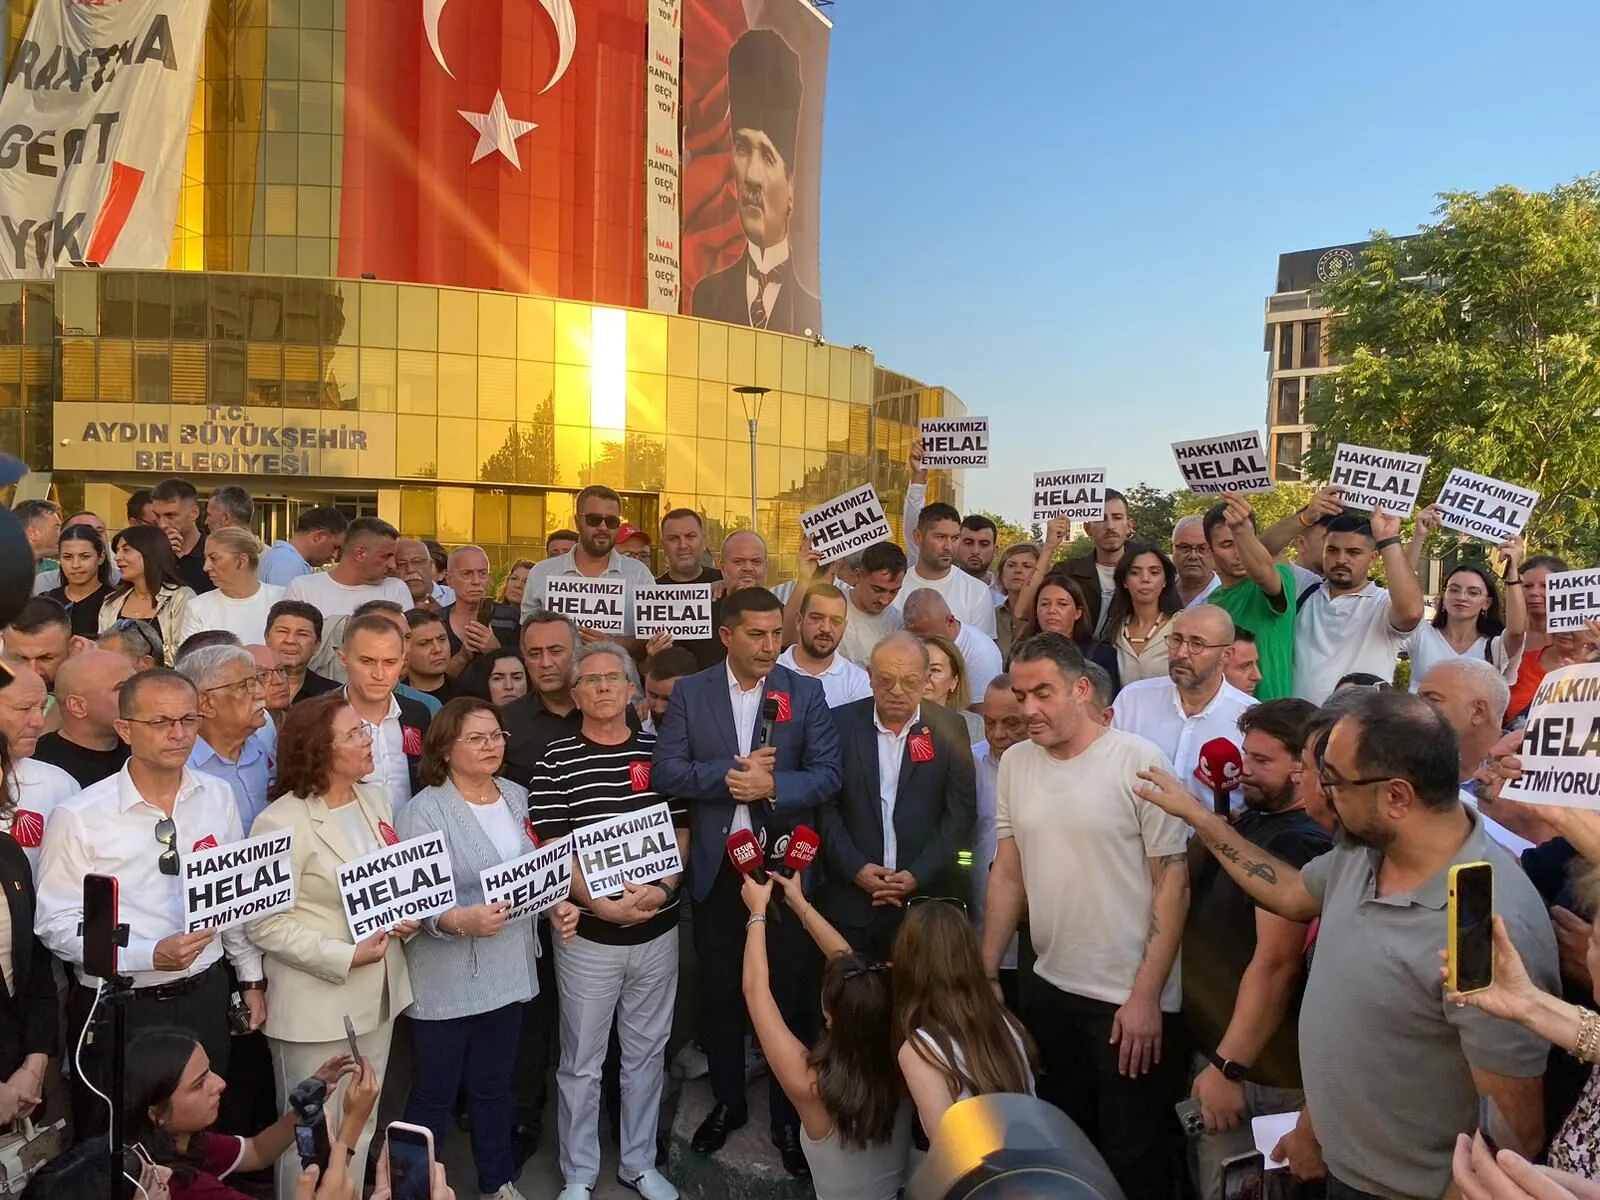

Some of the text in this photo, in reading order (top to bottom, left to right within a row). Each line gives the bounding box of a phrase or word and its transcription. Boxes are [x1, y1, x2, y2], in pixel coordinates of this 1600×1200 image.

[207, 406, 248, 421] T.C.
[921, 421, 986, 433] HAKKIMIZI
[82, 422, 368, 452] AYDIN BÜYÜKŞEHİR
[921, 436, 987, 452] HELAL
[1176, 437, 1258, 459] HAKKIMIZI
[136, 448, 309, 475] BELEDİYESİ
[921, 454, 986, 466] ETMİYORUZ!
[1182, 456, 1265, 481] HELAL
[1337, 450, 1421, 475] HAKKIMIZI
[1035, 473, 1103, 487] HAKKIMIZI
[1191, 477, 1271, 494] ETMİYORUZ!
[1333, 466, 1415, 498] HELAL
[1449, 474, 1533, 508] HAKKIMIZI
[803, 489, 874, 529] HAKKIMIZI
[1034, 488, 1103, 506] HELAL
[1331, 490, 1411, 513] TMİYORUZ!
[1442, 489, 1520, 530] HELAL
[811, 507, 884, 548] HELAL
[819, 525, 889, 560] ETMİYORUZ!
[549, 581, 623, 594] HAKKIMIZI
[636, 590, 709, 600] HAKKIMIZI
[548, 597, 623, 615] HELAL
[636, 605, 710, 621] HELAL
[1549, 592, 1600, 613] HEL
[1520, 718, 1600, 757] HELA
[1509, 767, 1600, 796] ETMİYORU
[578, 811, 669, 849] HAKKIMIZI
[187, 836, 291, 878] HAKKIMIZI
[340, 839, 444, 887] HAKKIMIZI
[583, 831, 676, 874] HELAL
[733, 842, 754, 857] CESUR
[486, 840, 571, 890] HAKKIMIZI
[590, 855, 679, 892] ETMİYORUZ!
[189, 860, 290, 913] HELAL
[346, 863, 450, 916] HELAL
[190, 889, 291, 933] ETMİYORUZ!
[353, 890, 453, 936] ETMİYORUZ!
[505, 885, 569, 921] MİYORUZ!
